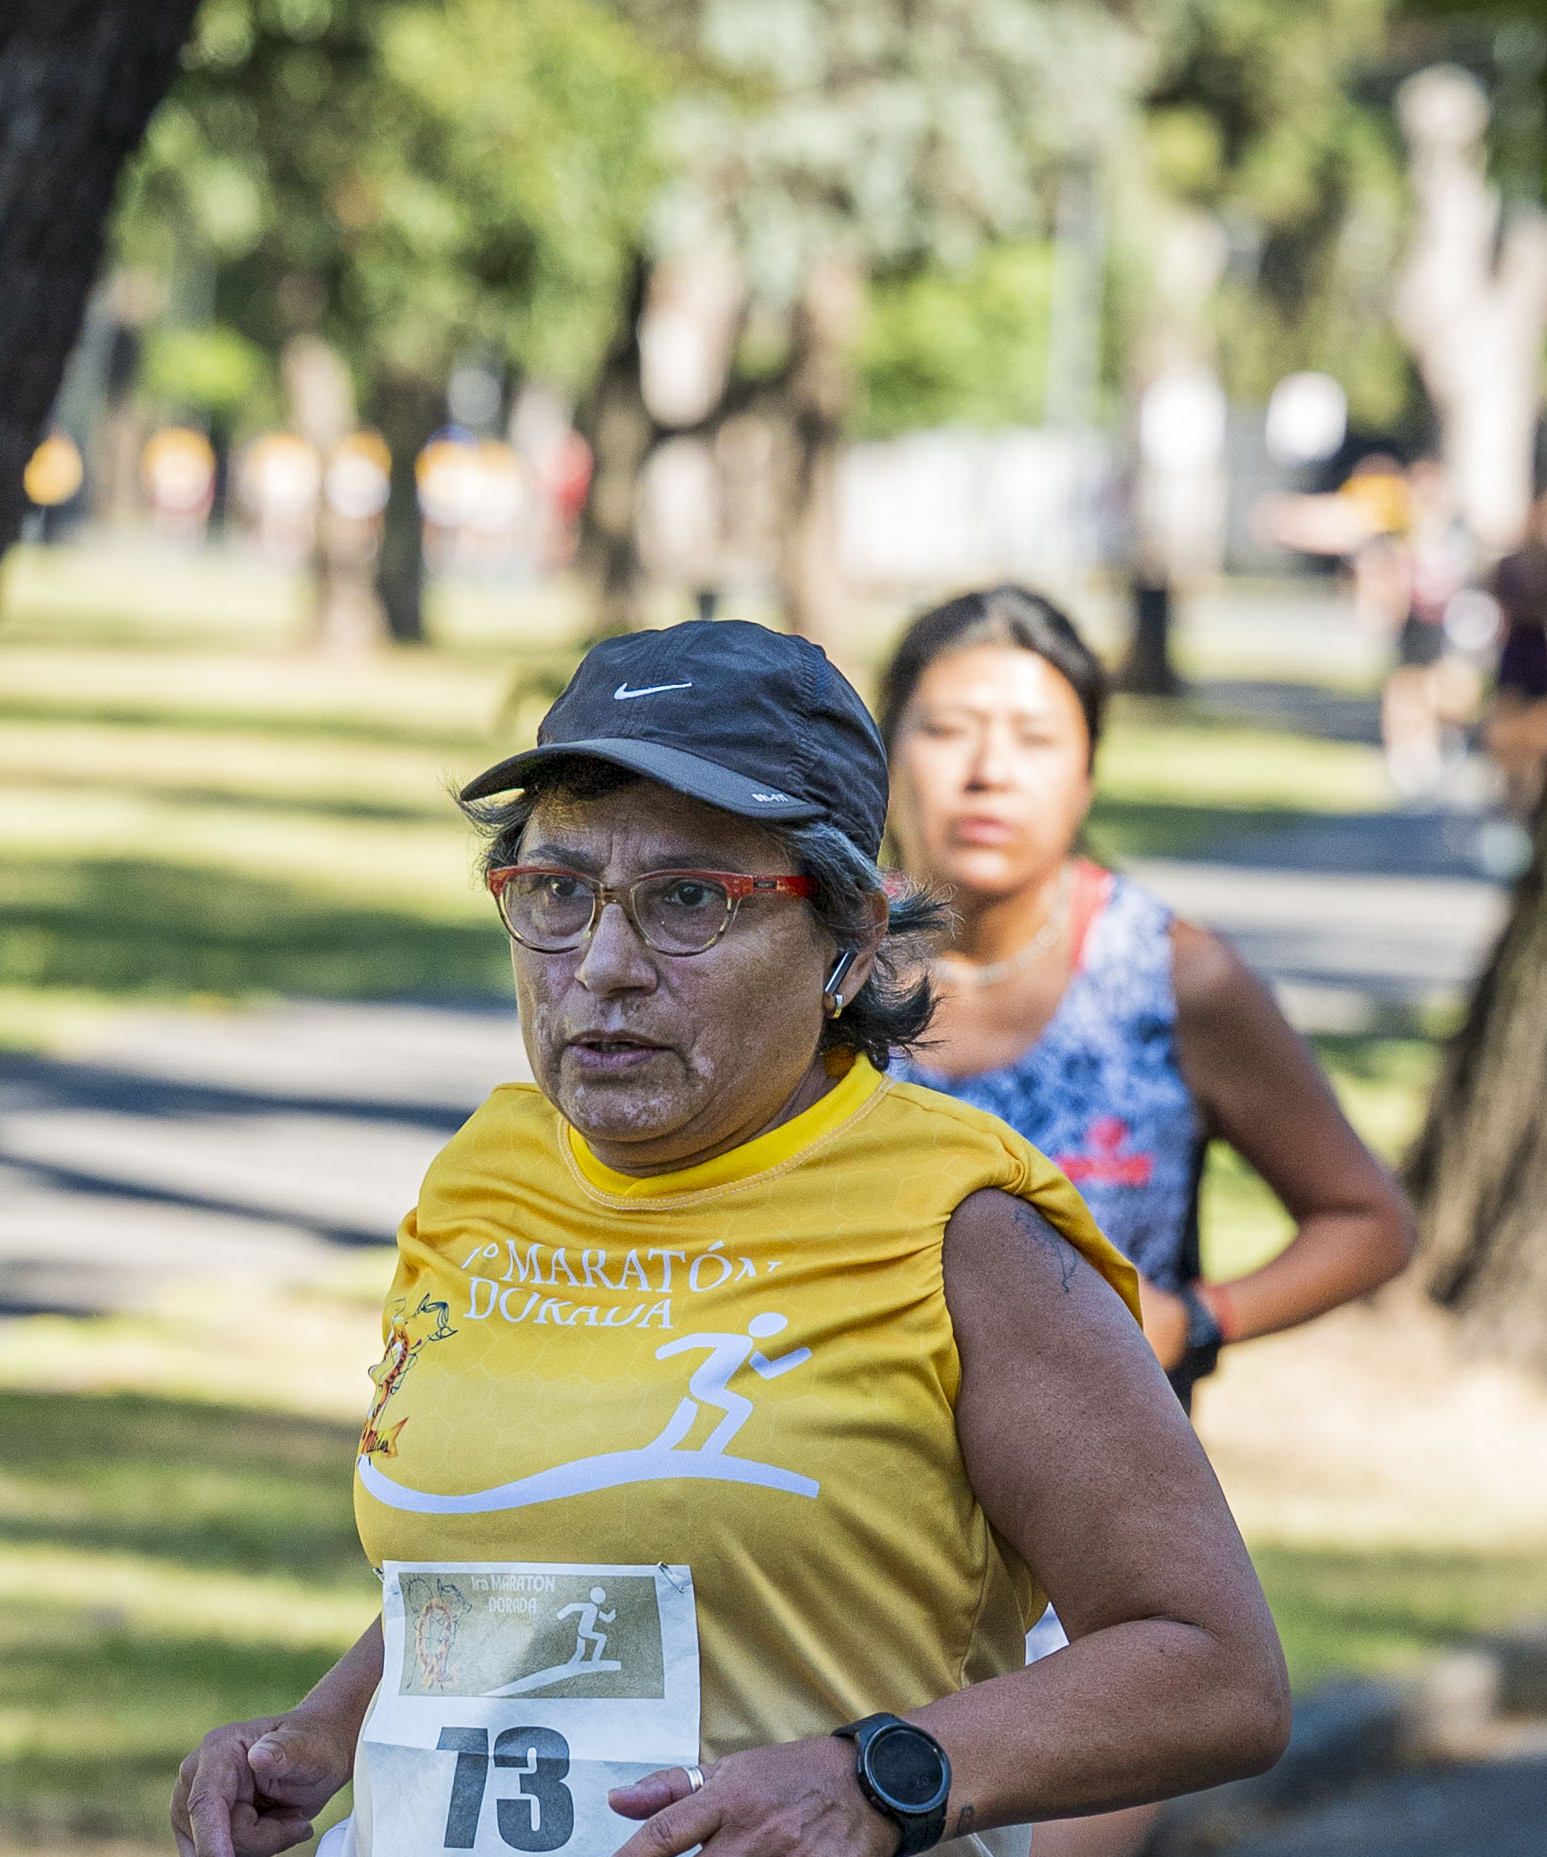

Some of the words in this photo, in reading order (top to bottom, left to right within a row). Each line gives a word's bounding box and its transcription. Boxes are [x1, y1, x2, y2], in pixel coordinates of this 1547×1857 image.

[499, 1240, 782, 1293] MARATÓ
[490, 1574, 556, 1593] MARATON
[488, 1596, 537, 1613] DORADA
[436, 1726, 574, 1853] 73
